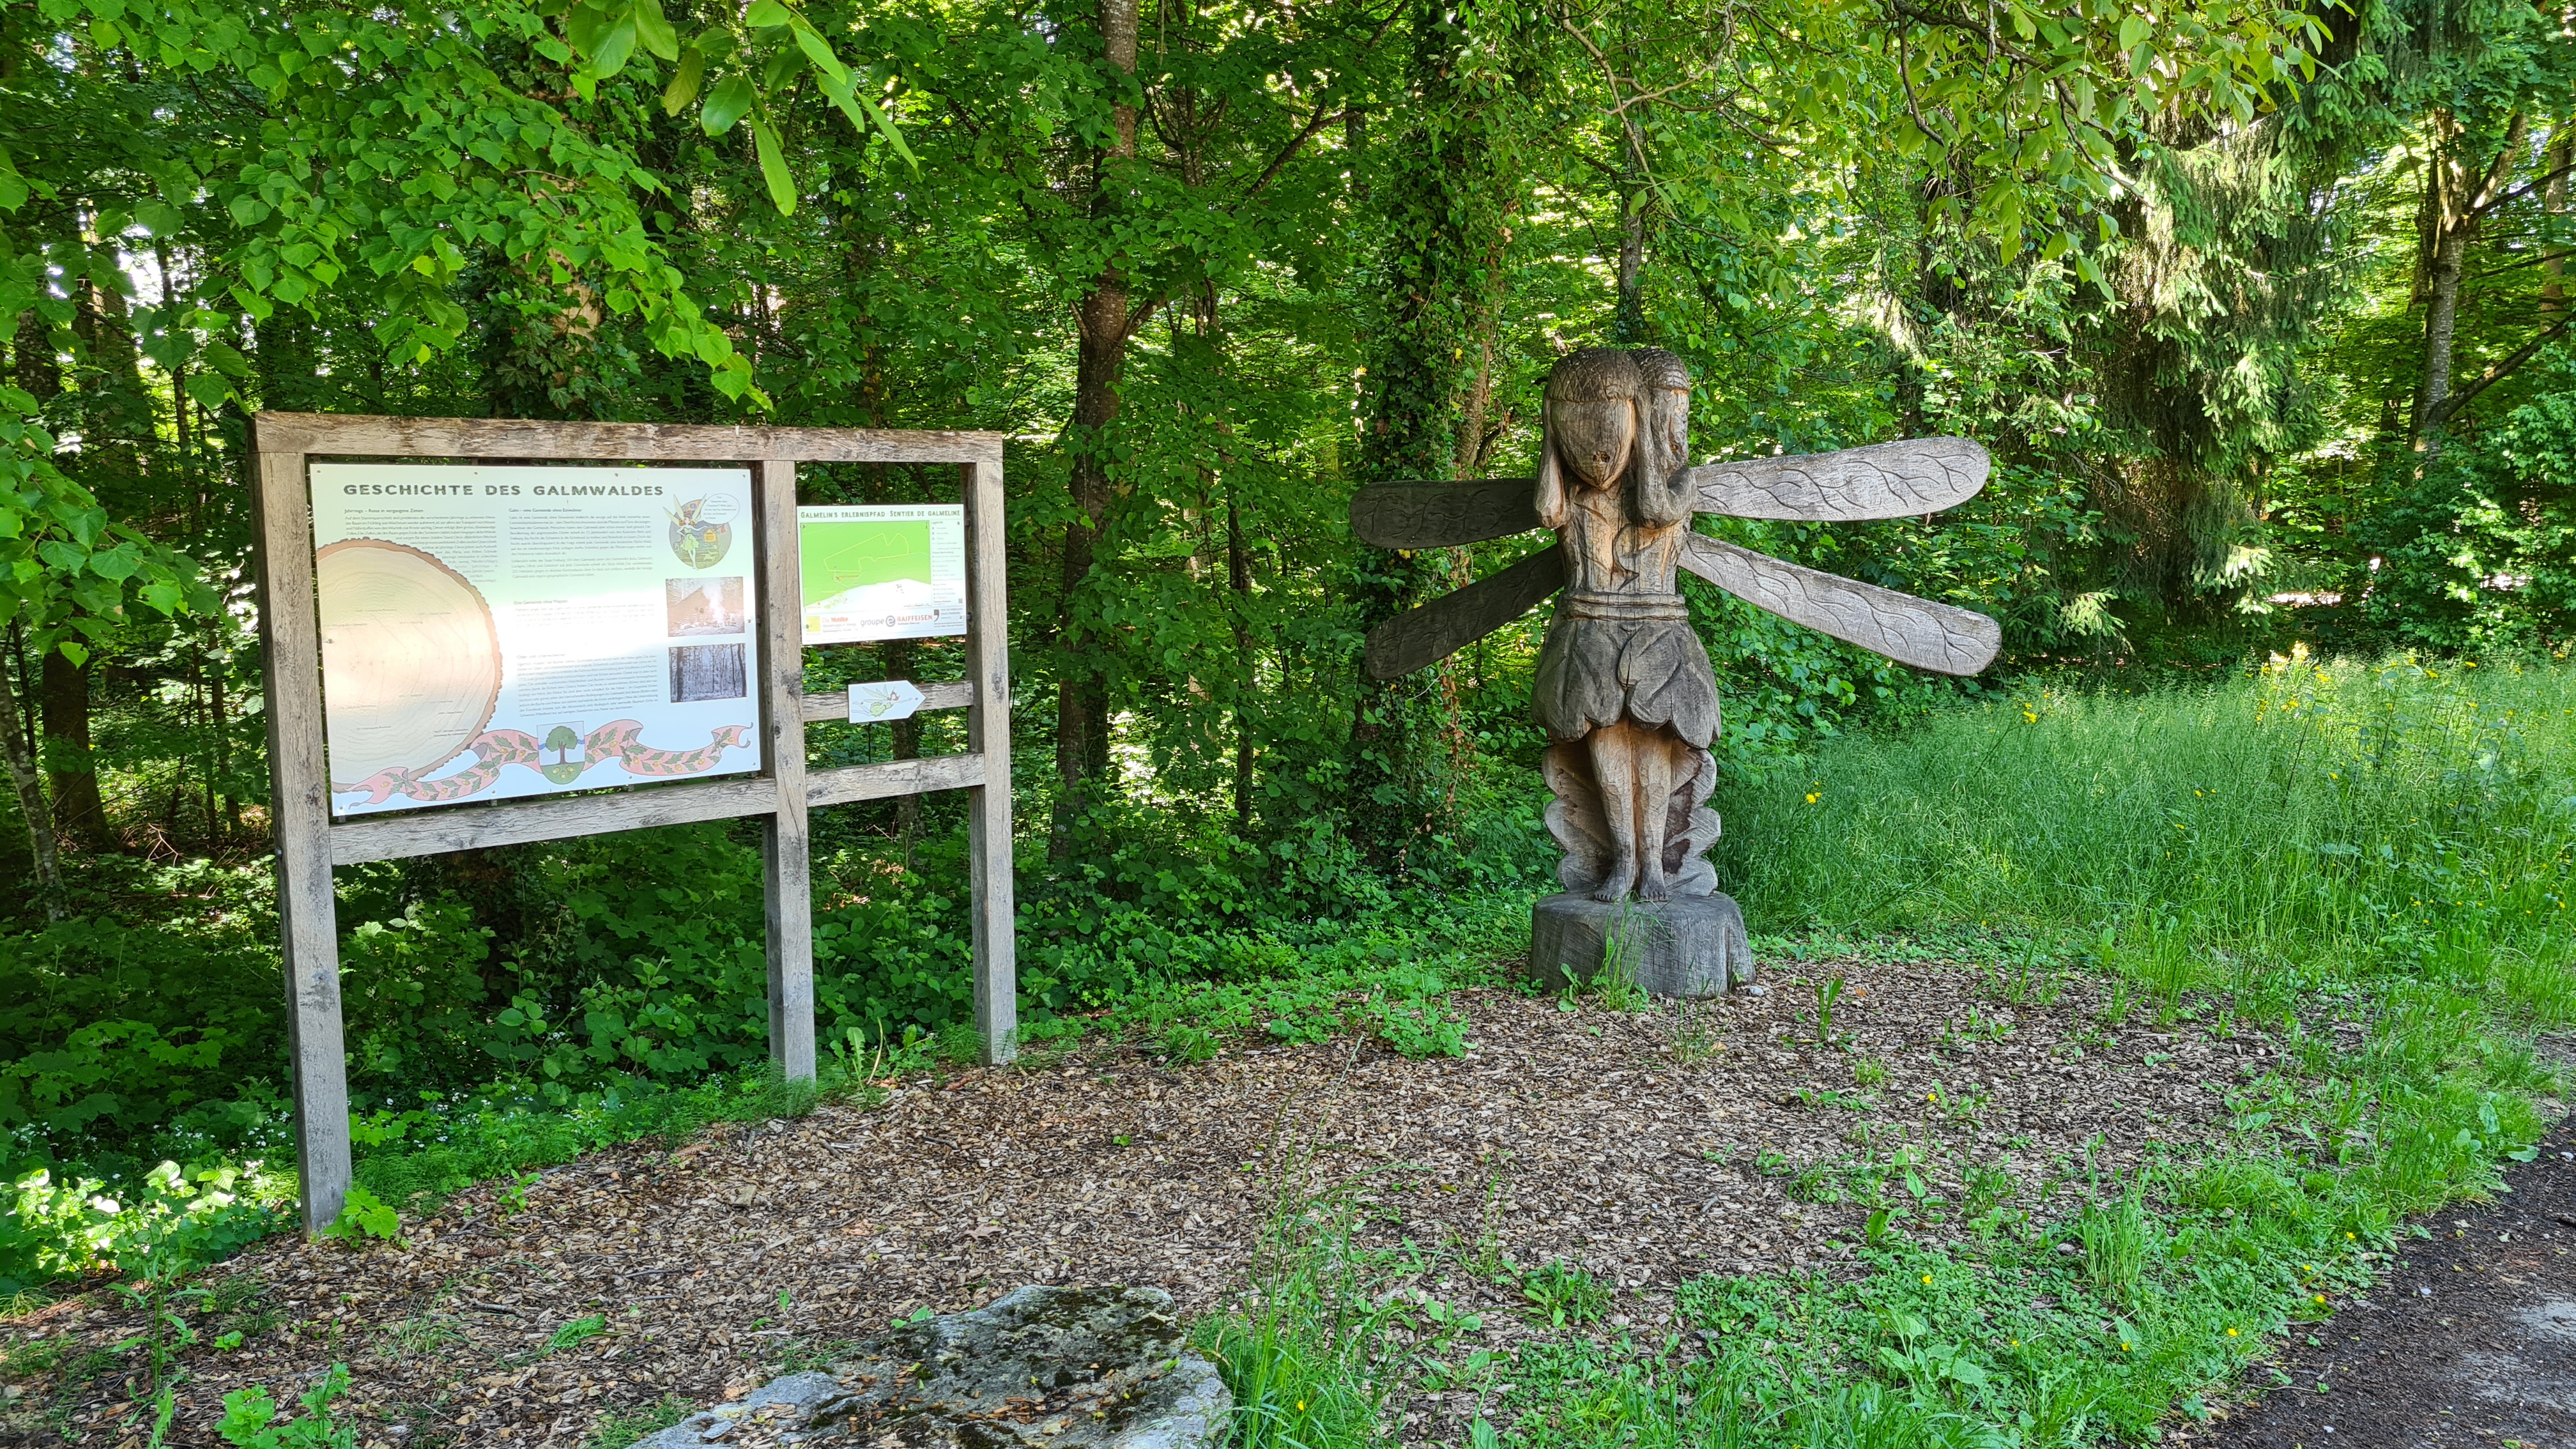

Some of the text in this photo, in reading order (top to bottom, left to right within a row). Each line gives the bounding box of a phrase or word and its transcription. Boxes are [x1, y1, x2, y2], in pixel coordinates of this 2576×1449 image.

[344, 484, 664, 496] GESCHICHTE DES GALMWALDES
[861, 618, 885, 627] groupe
